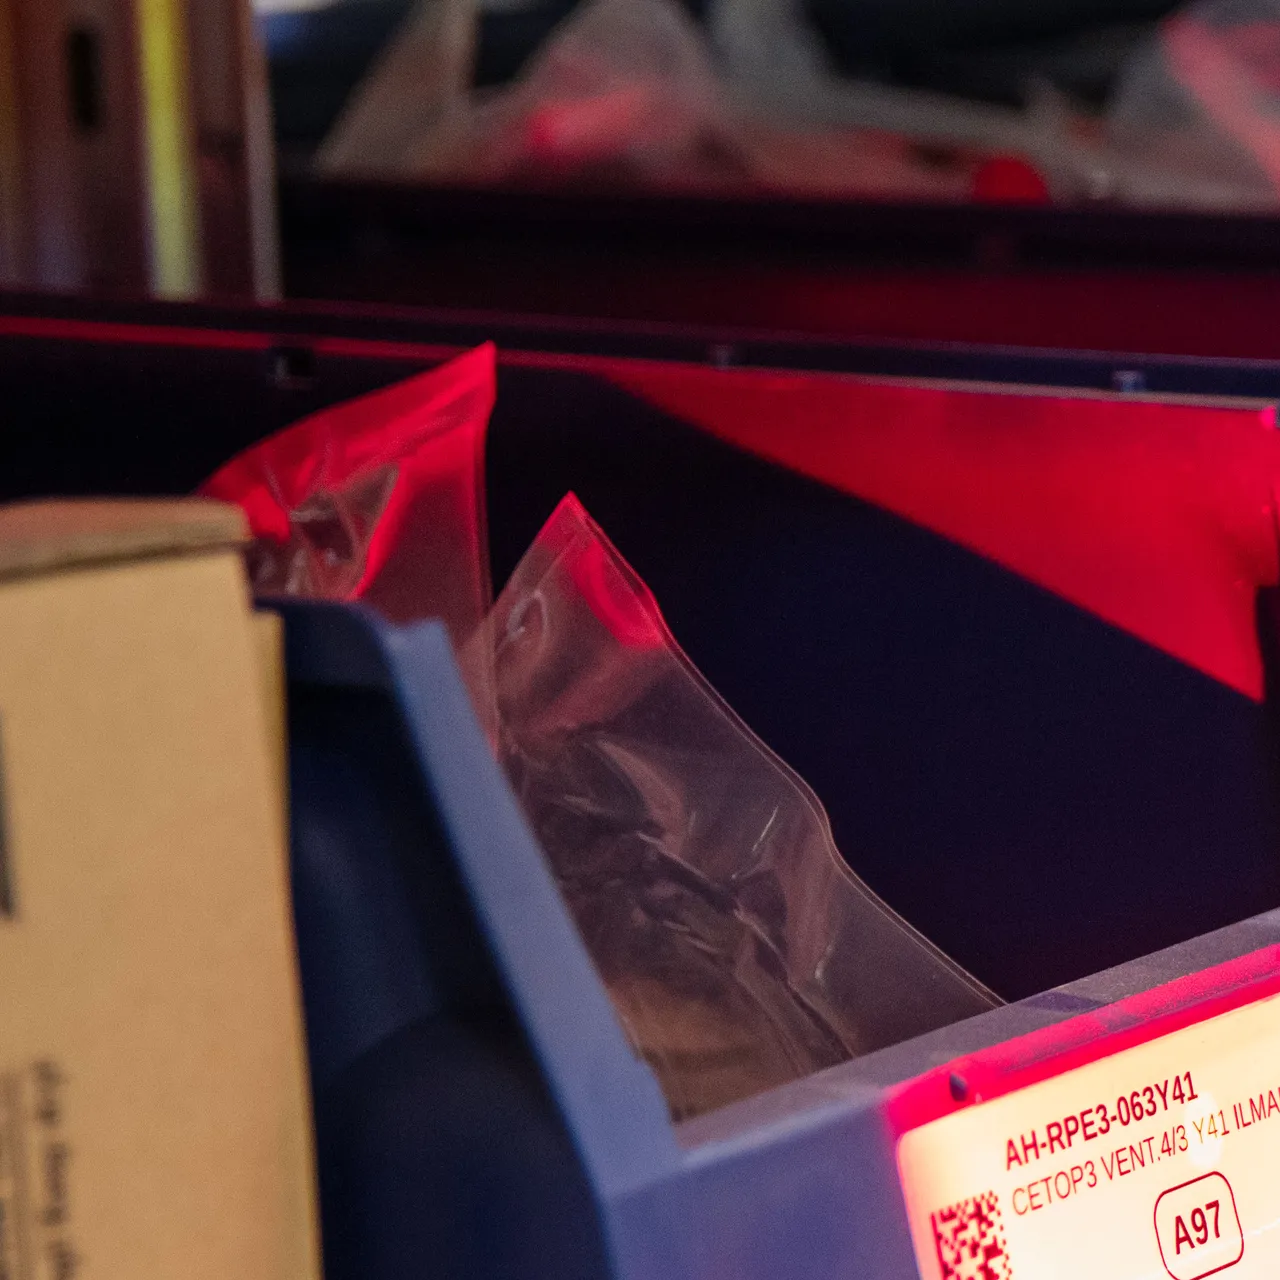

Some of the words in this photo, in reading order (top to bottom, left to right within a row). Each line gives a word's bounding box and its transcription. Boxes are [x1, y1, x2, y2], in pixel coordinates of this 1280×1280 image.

[1005, 1070, 1198, 1170] AH-RPE3-063Y41
[1012, 1161, 1098, 1216] CETOP3
[1101, 1121, 1189, 1182] VENT.4/3
[1192, 1109, 1230, 1147] Y41
[1174, 1200, 1221, 1255] A97
